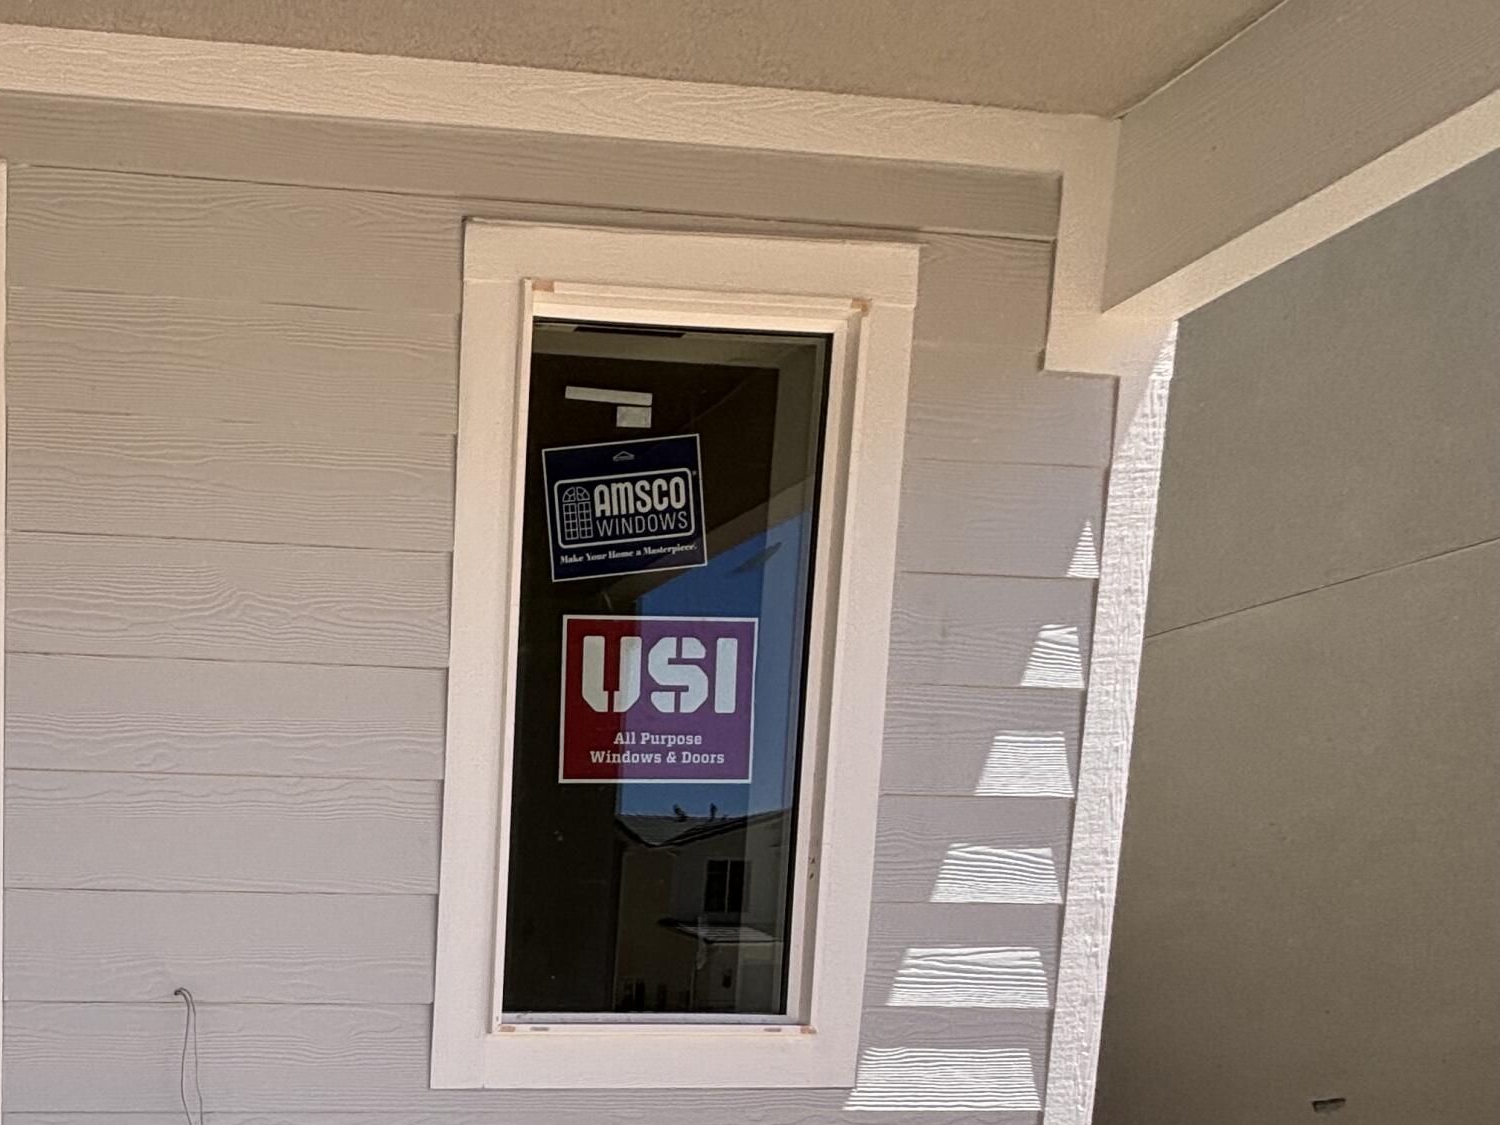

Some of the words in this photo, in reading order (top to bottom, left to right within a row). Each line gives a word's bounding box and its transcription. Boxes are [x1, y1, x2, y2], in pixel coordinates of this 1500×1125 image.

[594, 476, 686, 518] AMSCO
[596, 511, 688, 537] WINDOWS
[560, 554, 584, 565] Make
[585, 552, 608, 561] Your
[608, 550, 634, 559] Home
[582, 635, 738, 714] USI
[613, 732, 636, 745] All
[640, 732, 703, 747] Purpose
[590, 750, 662, 764] Windows
[666, 751, 677, 764] &
[682, 751, 725, 764] Doors
